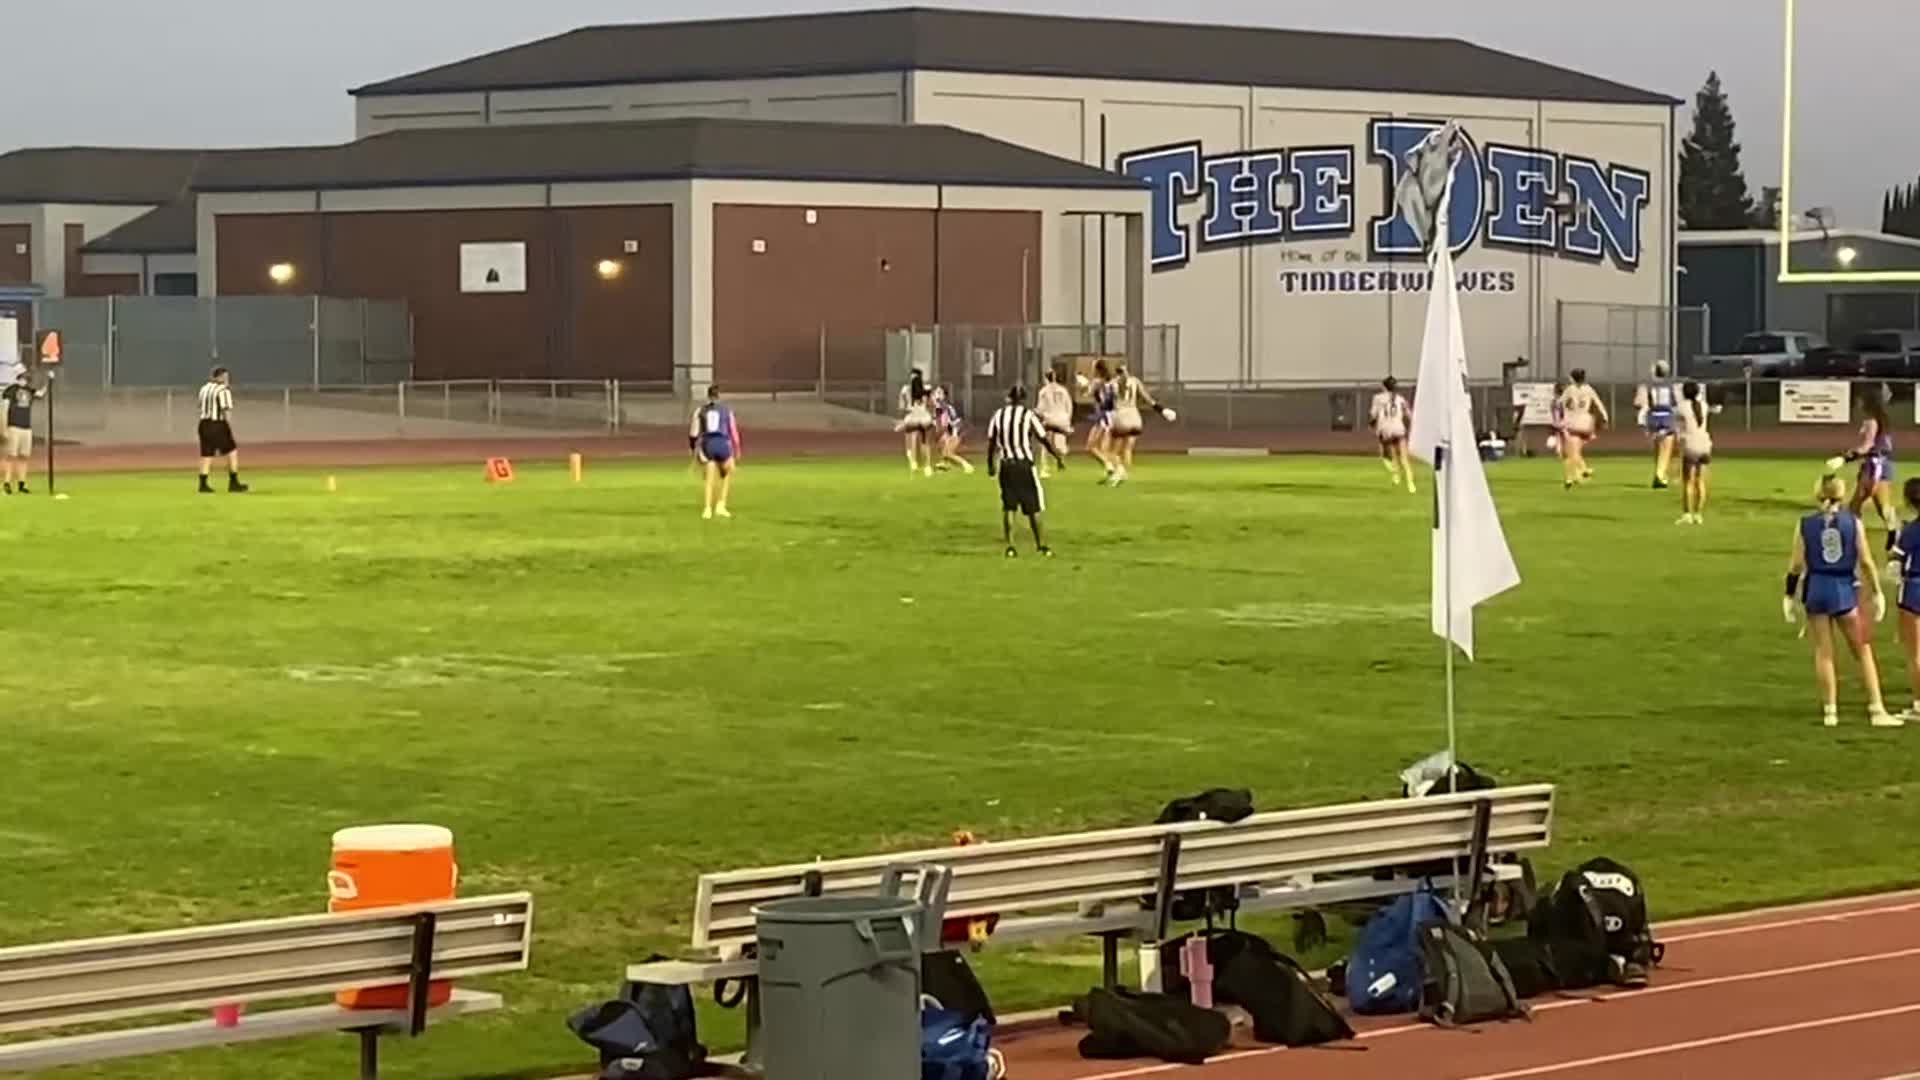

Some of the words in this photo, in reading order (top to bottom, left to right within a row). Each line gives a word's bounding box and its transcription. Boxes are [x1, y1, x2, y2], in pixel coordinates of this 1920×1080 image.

[1117, 138, 1356, 270] THE
[1370, 117, 1651, 270] DEN
[41, 331, 60, 363] 4
[493, 459, 509, 478] G
